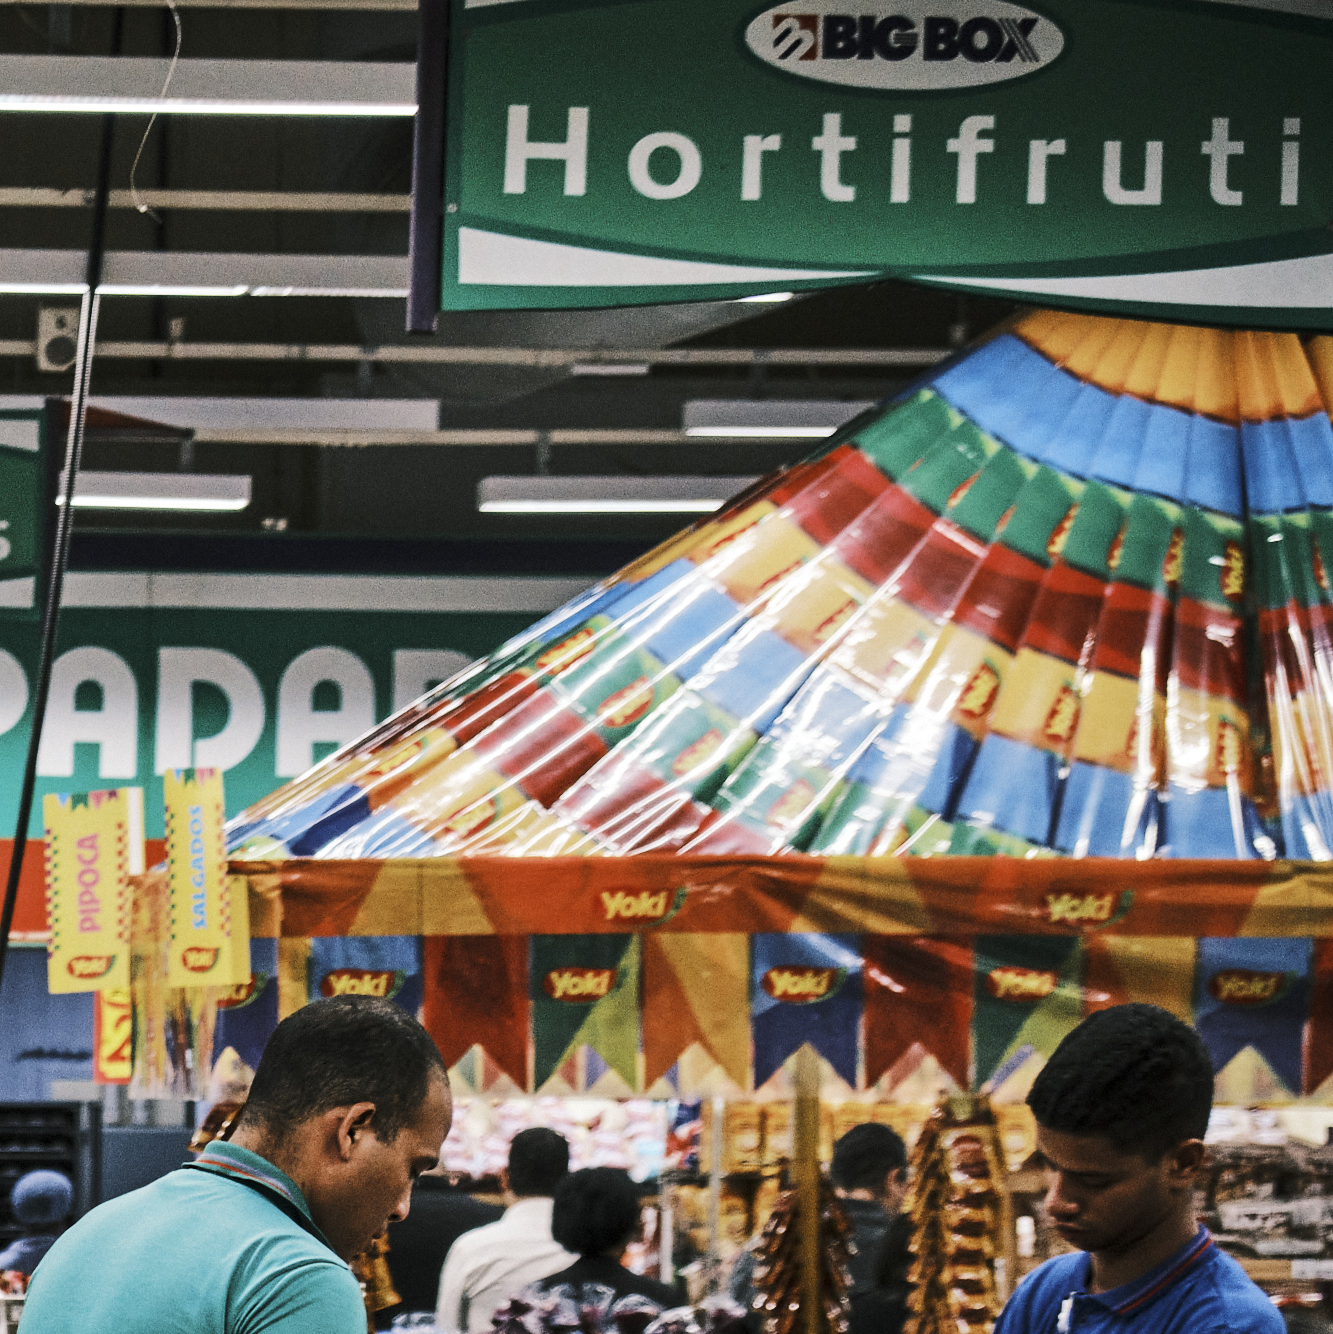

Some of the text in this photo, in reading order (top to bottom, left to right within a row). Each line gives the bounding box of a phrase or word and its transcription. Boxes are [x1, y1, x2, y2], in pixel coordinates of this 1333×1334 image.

[821, 15, 1041, 64] BIG BOX
[502, 104, 1302, 206] Hortifruti
[76, 833, 101, 933] PIPOCA
[188, 804, 208, 930] SALGADOS
[600, 889, 669, 922] Yoki
[1046, 892, 1114, 923] Yoki
[549, 970, 611, 999] Yoki
[769, 967, 833, 998] Yoki
[992, 967, 1053, 997] Yoki
